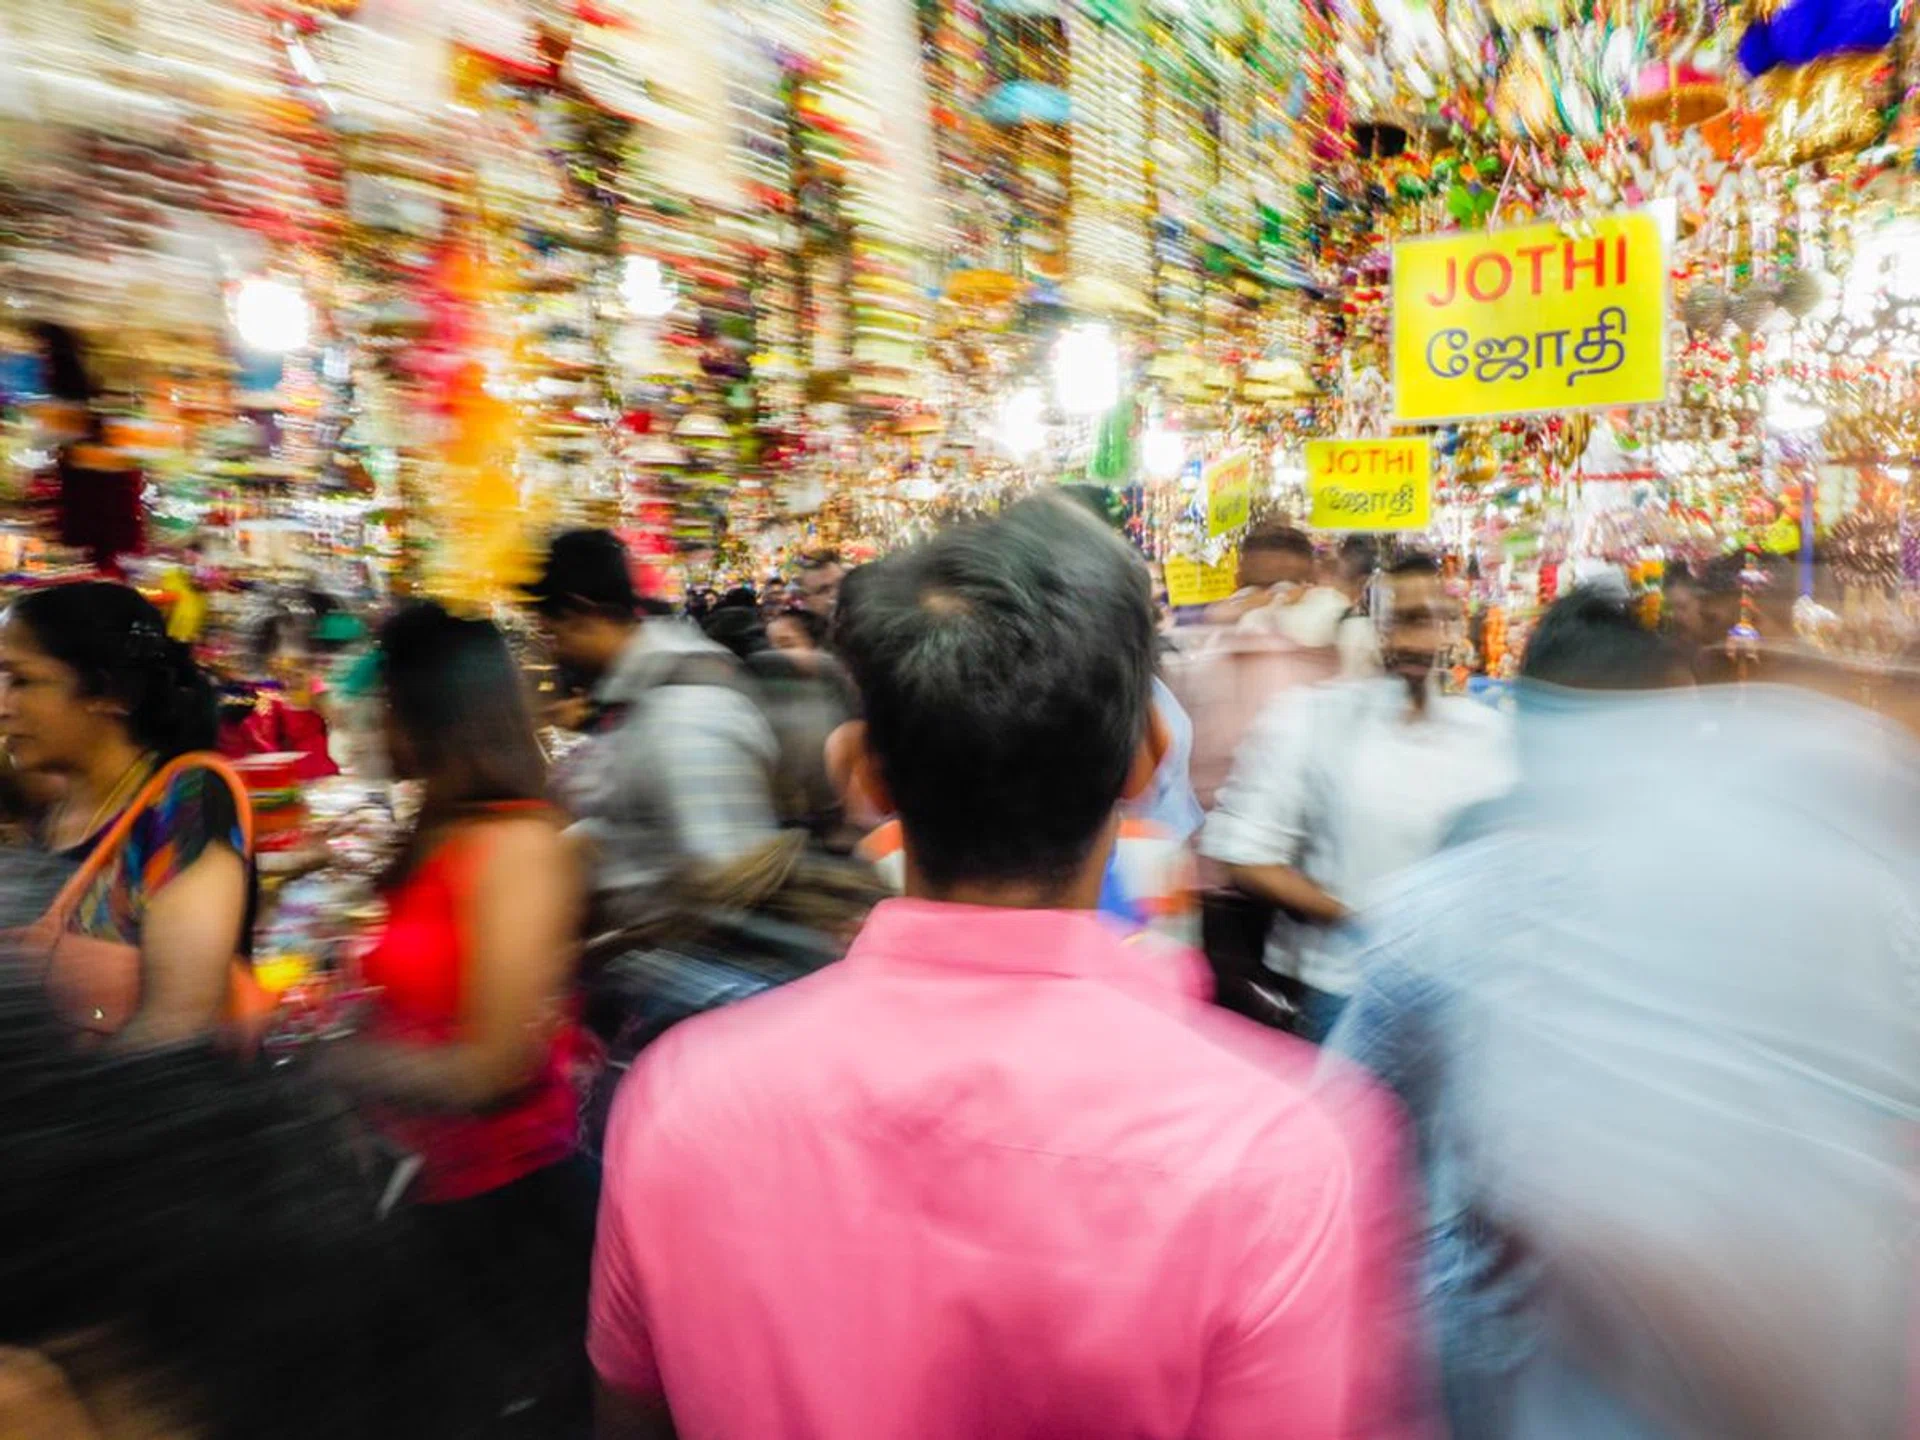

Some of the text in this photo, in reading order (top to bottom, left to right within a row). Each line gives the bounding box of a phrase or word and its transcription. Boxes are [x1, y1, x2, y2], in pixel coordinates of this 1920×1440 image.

[1426, 235, 1627, 307] JOTHI
[1426, 306, 1627, 387] ஜோதி
[1320, 448, 1414, 475] JOTHI
